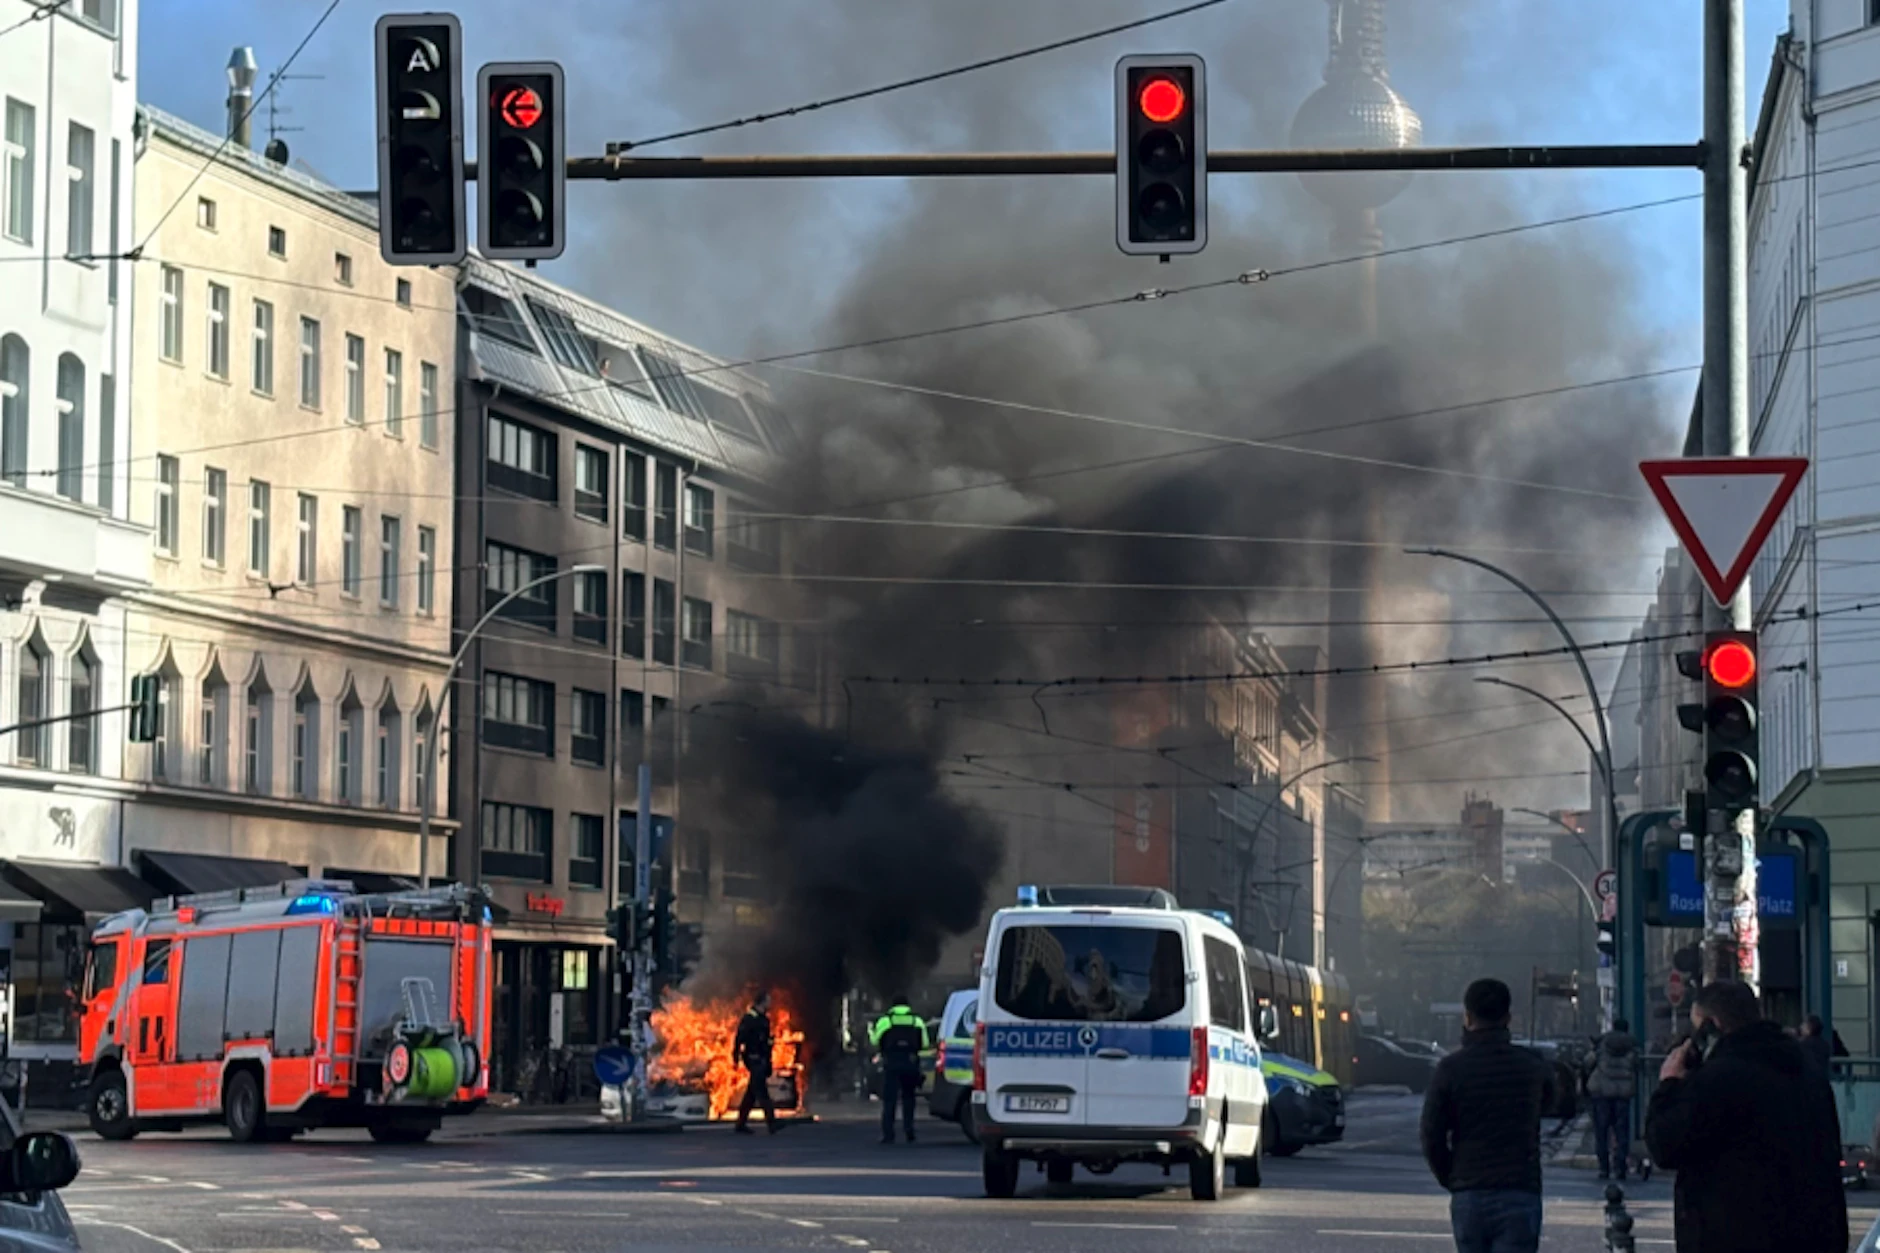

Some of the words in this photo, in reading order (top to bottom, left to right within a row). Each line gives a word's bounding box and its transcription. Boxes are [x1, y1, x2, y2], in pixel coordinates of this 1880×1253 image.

[406, 48, 431, 73] A
[1669, 893, 1704, 911] Rose
[1758, 895, 1794, 914] Platz
[992, 1031, 1072, 1049] POLIZEI
